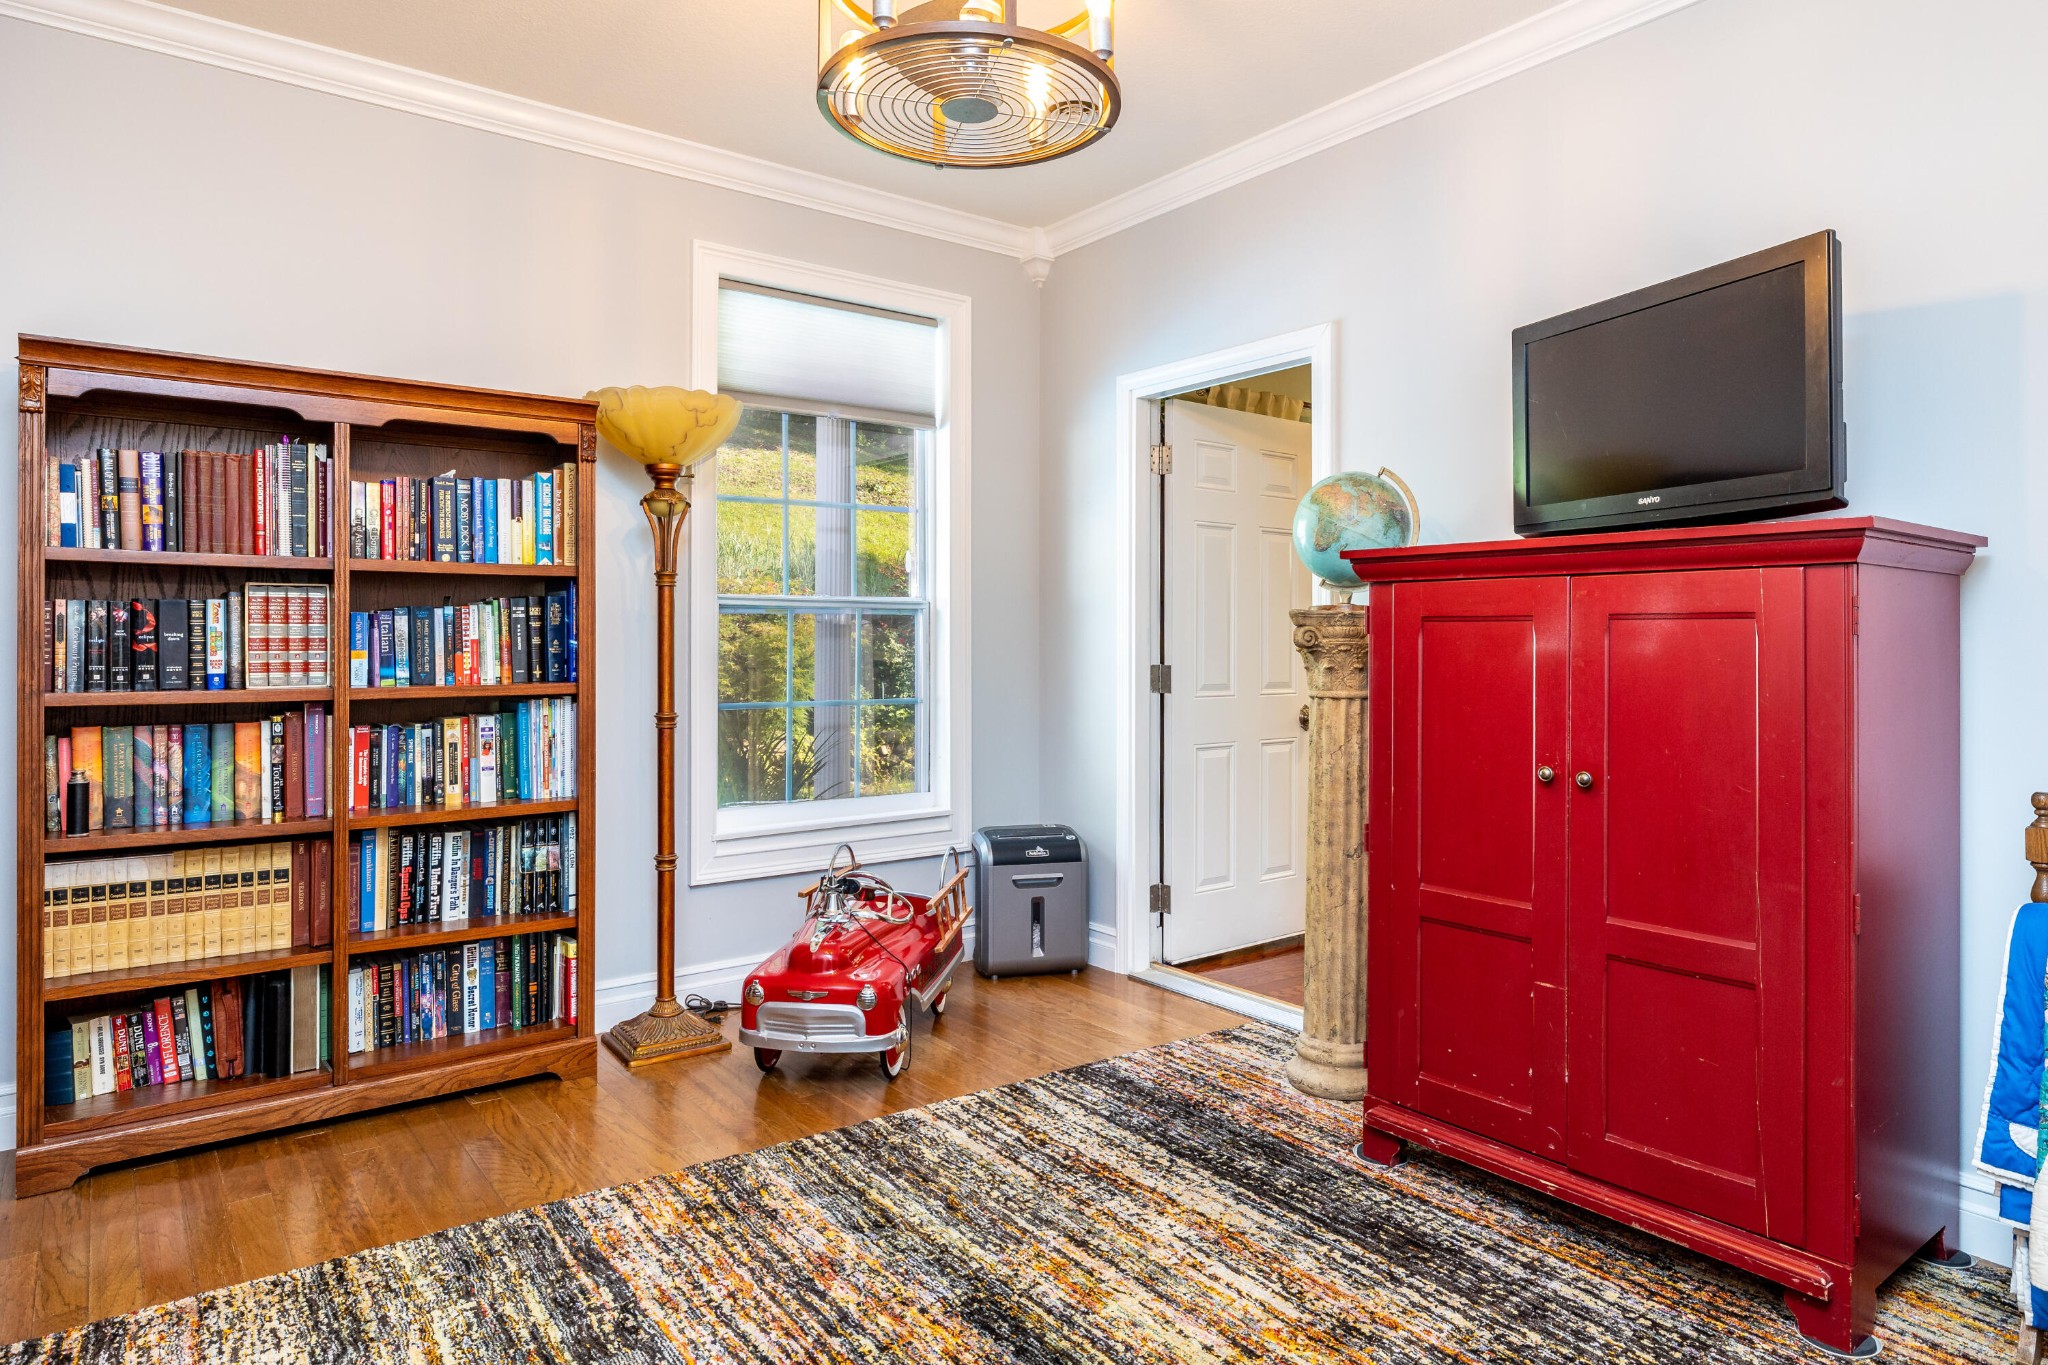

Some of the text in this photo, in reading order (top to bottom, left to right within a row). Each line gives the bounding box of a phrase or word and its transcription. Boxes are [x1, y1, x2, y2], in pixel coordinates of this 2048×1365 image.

[142, 453, 161, 478] DUNE
[460, 497, 470, 523] MOBY
[1637, 496, 1660, 505] SANYO
[355, 533, 364, 556] Ashes
[460, 524, 470, 546] DICK
[380, 620, 392, 653] Italian
[71, 626, 81, 682] Clockwork Prince
[273, 764, 282, 800] TOLKIEN
[366, 843, 374, 892] Tutankhamen
[451, 858, 461, 866] In
[399, 836, 413, 919] Griffin Special Ops
[430, 836, 442, 915] Griffin Under Fire
[448, 867, 461, 895] Danger's
[449, 895, 460, 911] Path
[450, 963, 462, 1012] City of Glass
[467, 985, 478, 1006] Secret
[467, 1007, 478, 1028] Honor
[118, 1028, 128, 1053] DUNE
[134, 1025, 145, 1051] DUNE
[159, 1014, 174, 1058] FLORENCE
